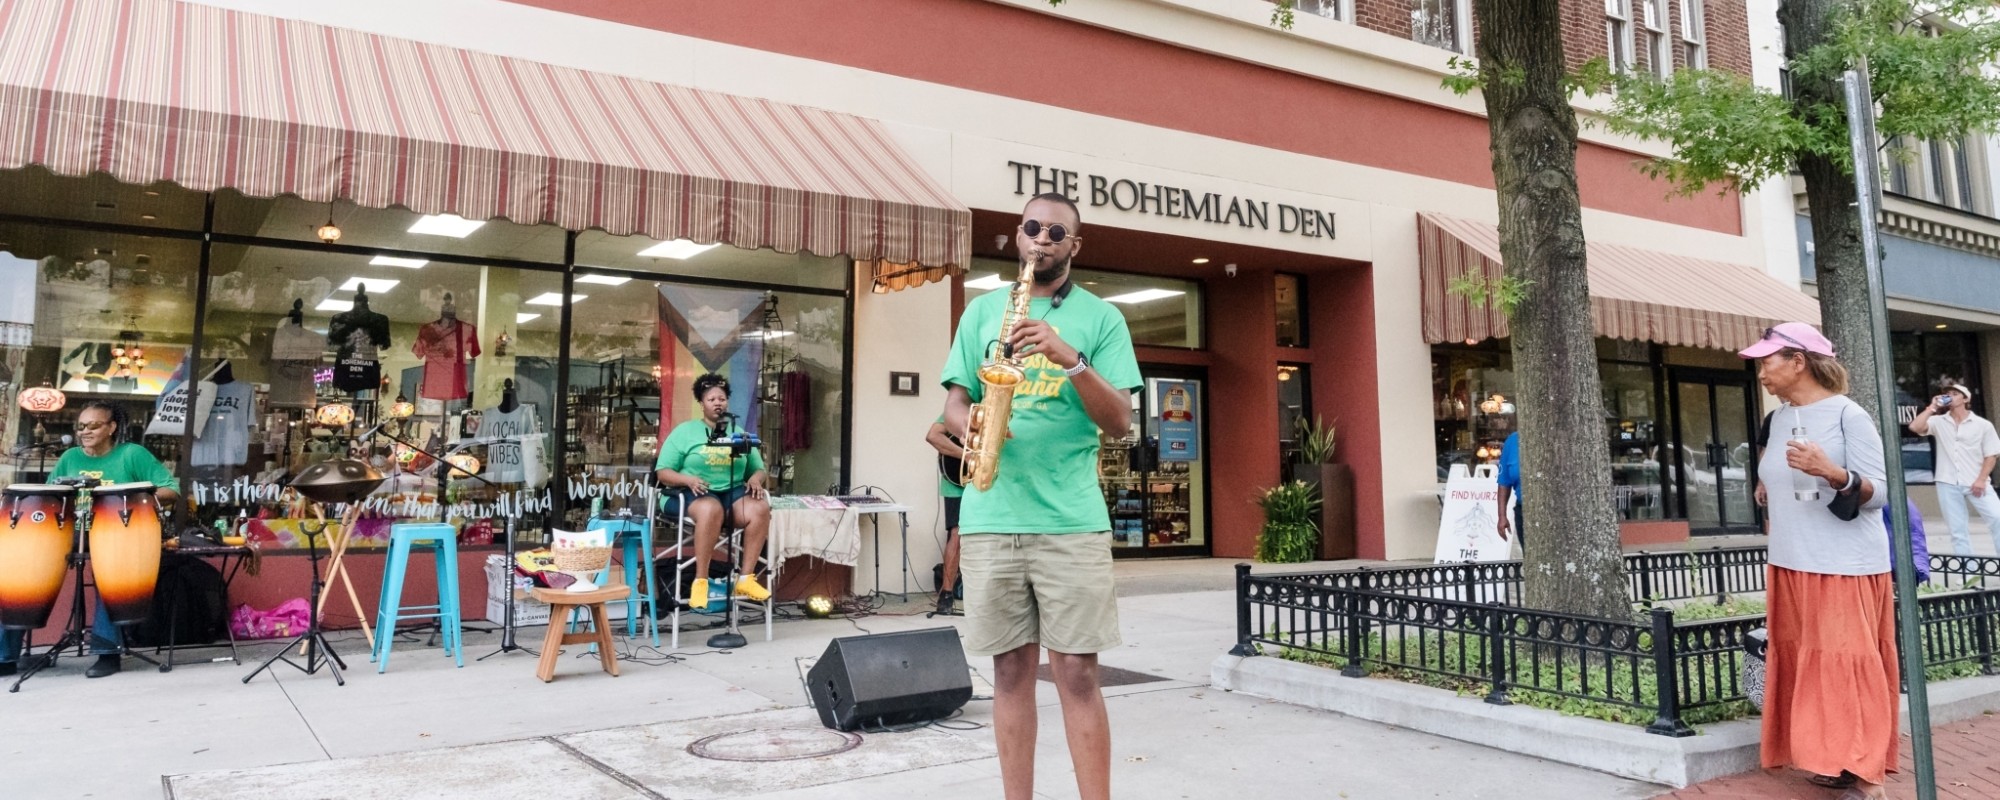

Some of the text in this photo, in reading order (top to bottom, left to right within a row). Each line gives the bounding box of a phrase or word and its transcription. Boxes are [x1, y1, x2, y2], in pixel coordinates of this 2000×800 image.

[1008, 160, 1336, 241] THE BOHEMIAN DEN
[341, 359, 374, 367] BOHEMIAN
[1013, 371, 1067, 397] and
[164, 395, 188, 405] shop
[162, 403, 187, 414] love
[490, 444, 520, 465] VIBES
[192, 480, 208, 506] It
[213, 482, 232, 503] is
[514, 487, 553, 519] find
[1451, 490, 1470, 500] FIND
[1470, 491, 1491, 501] YOUR
[1460, 548, 1479, 559] THE
